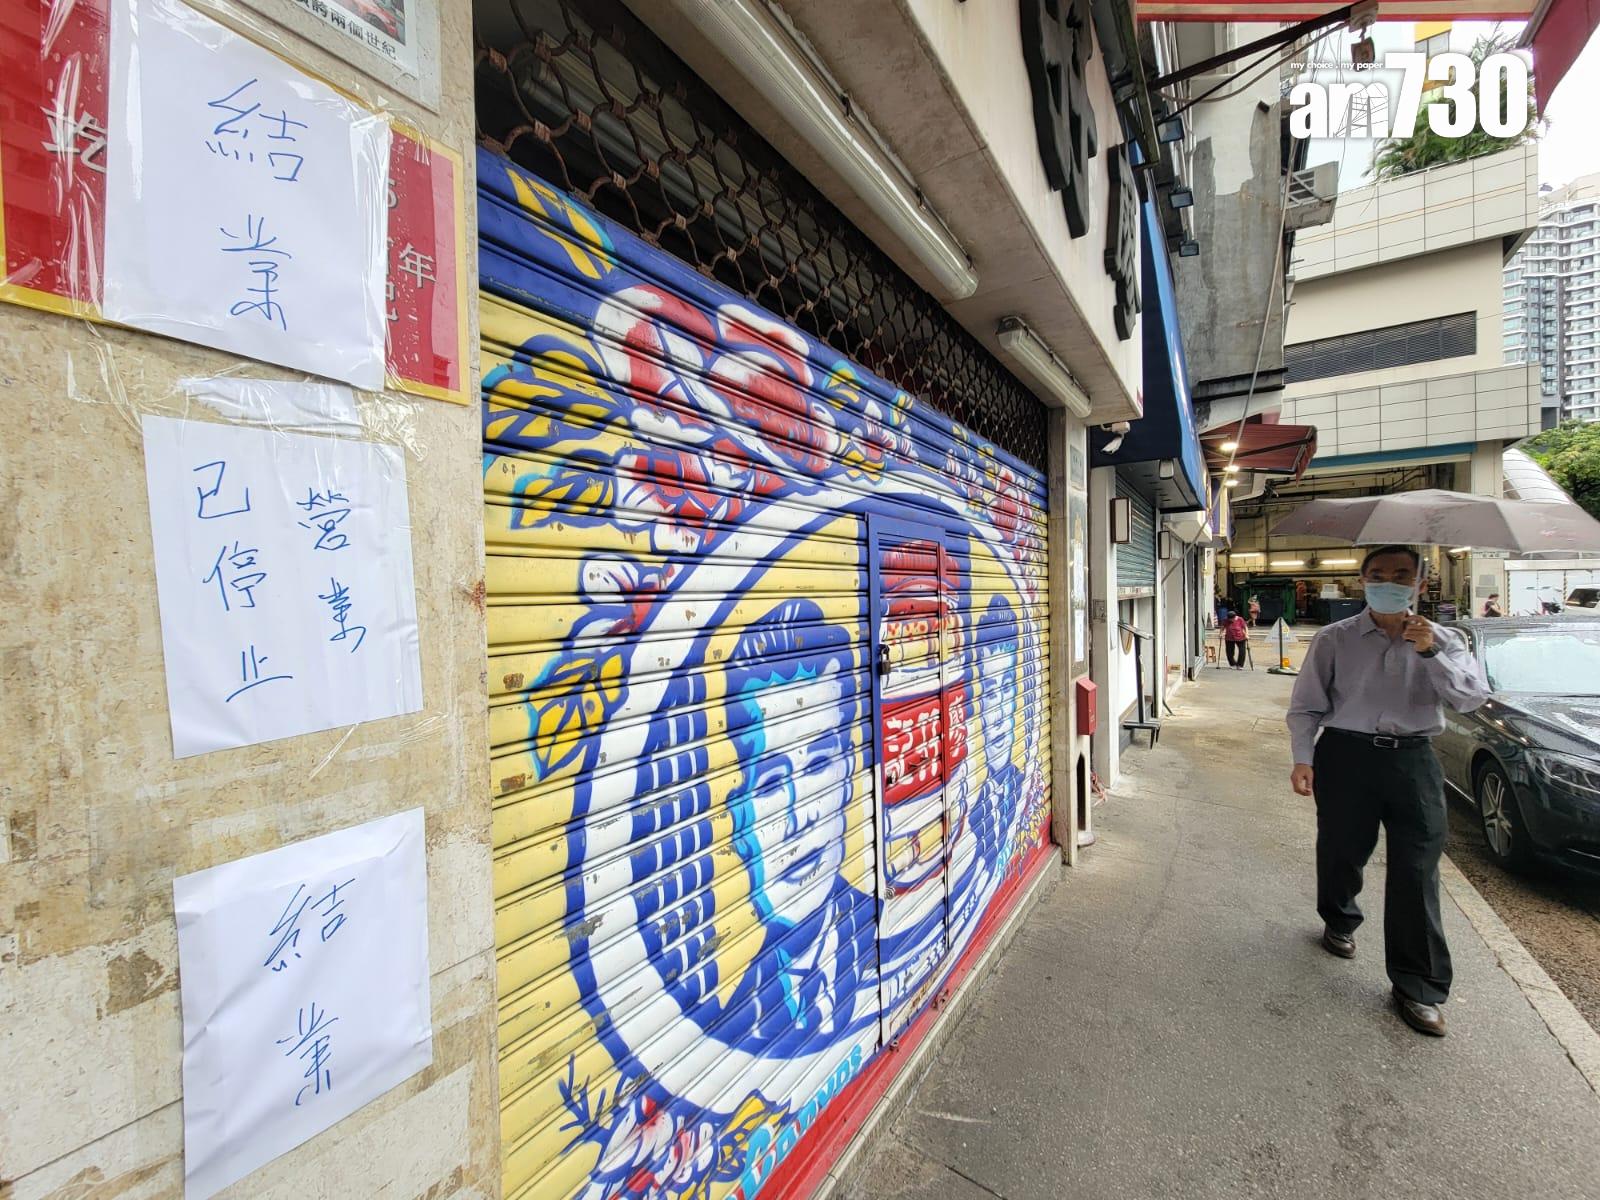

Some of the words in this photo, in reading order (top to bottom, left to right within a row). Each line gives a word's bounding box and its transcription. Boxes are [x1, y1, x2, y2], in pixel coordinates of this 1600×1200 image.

[206, 78, 309, 332] 結業
[193, 460, 294, 703] 已停止
[297, 487, 367, 653] 營業
[264, 877, 356, 1106] 結業
